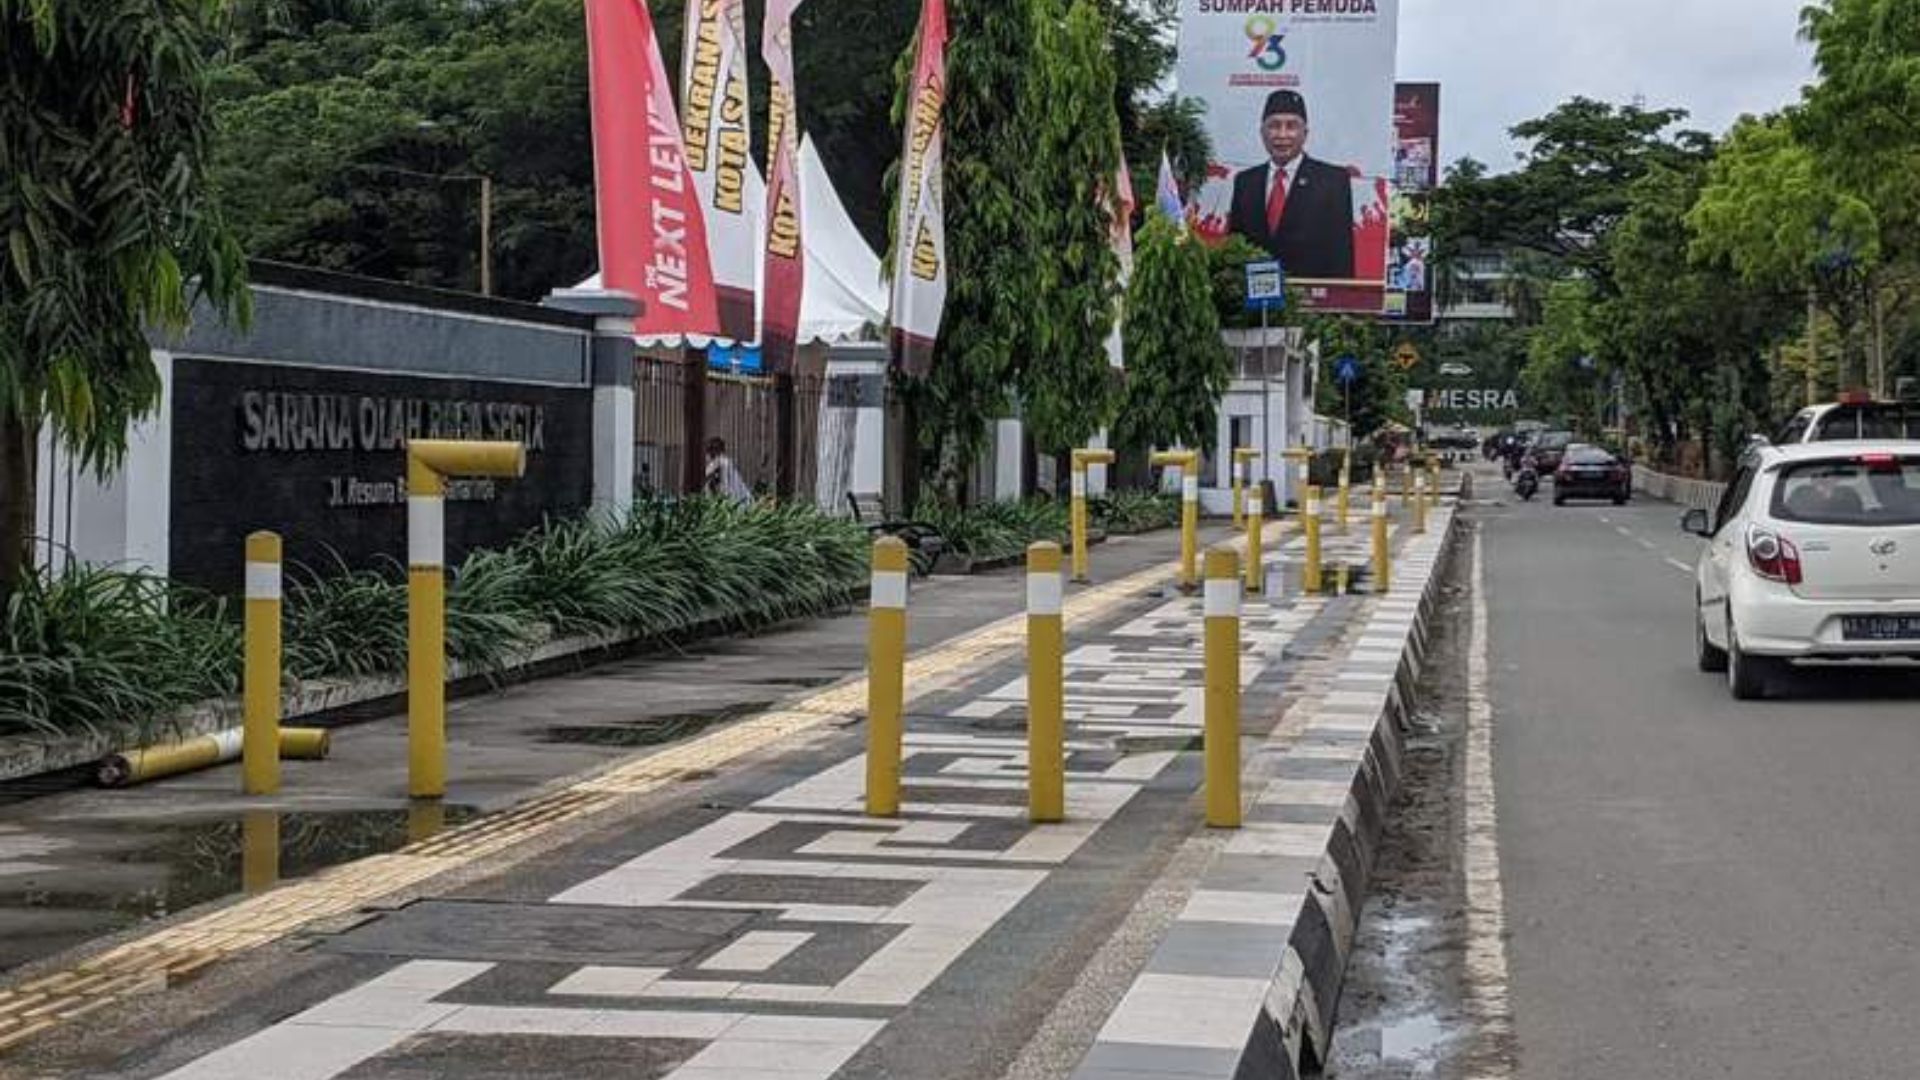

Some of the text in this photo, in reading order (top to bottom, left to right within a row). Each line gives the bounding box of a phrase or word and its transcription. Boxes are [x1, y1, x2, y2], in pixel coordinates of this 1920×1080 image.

[1199, 0, 1376, 13] SUMPAH PEMUDA
[1245, 15, 1286, 71] 93
[713, 127, 746, 213] KOTA
[651, 198, 689, 310] NEXT
[243, 390, 353, 450] SARANA
[360, 397, 421, 450] OLAH
[1427, 389, 1520, 409] MESRA
